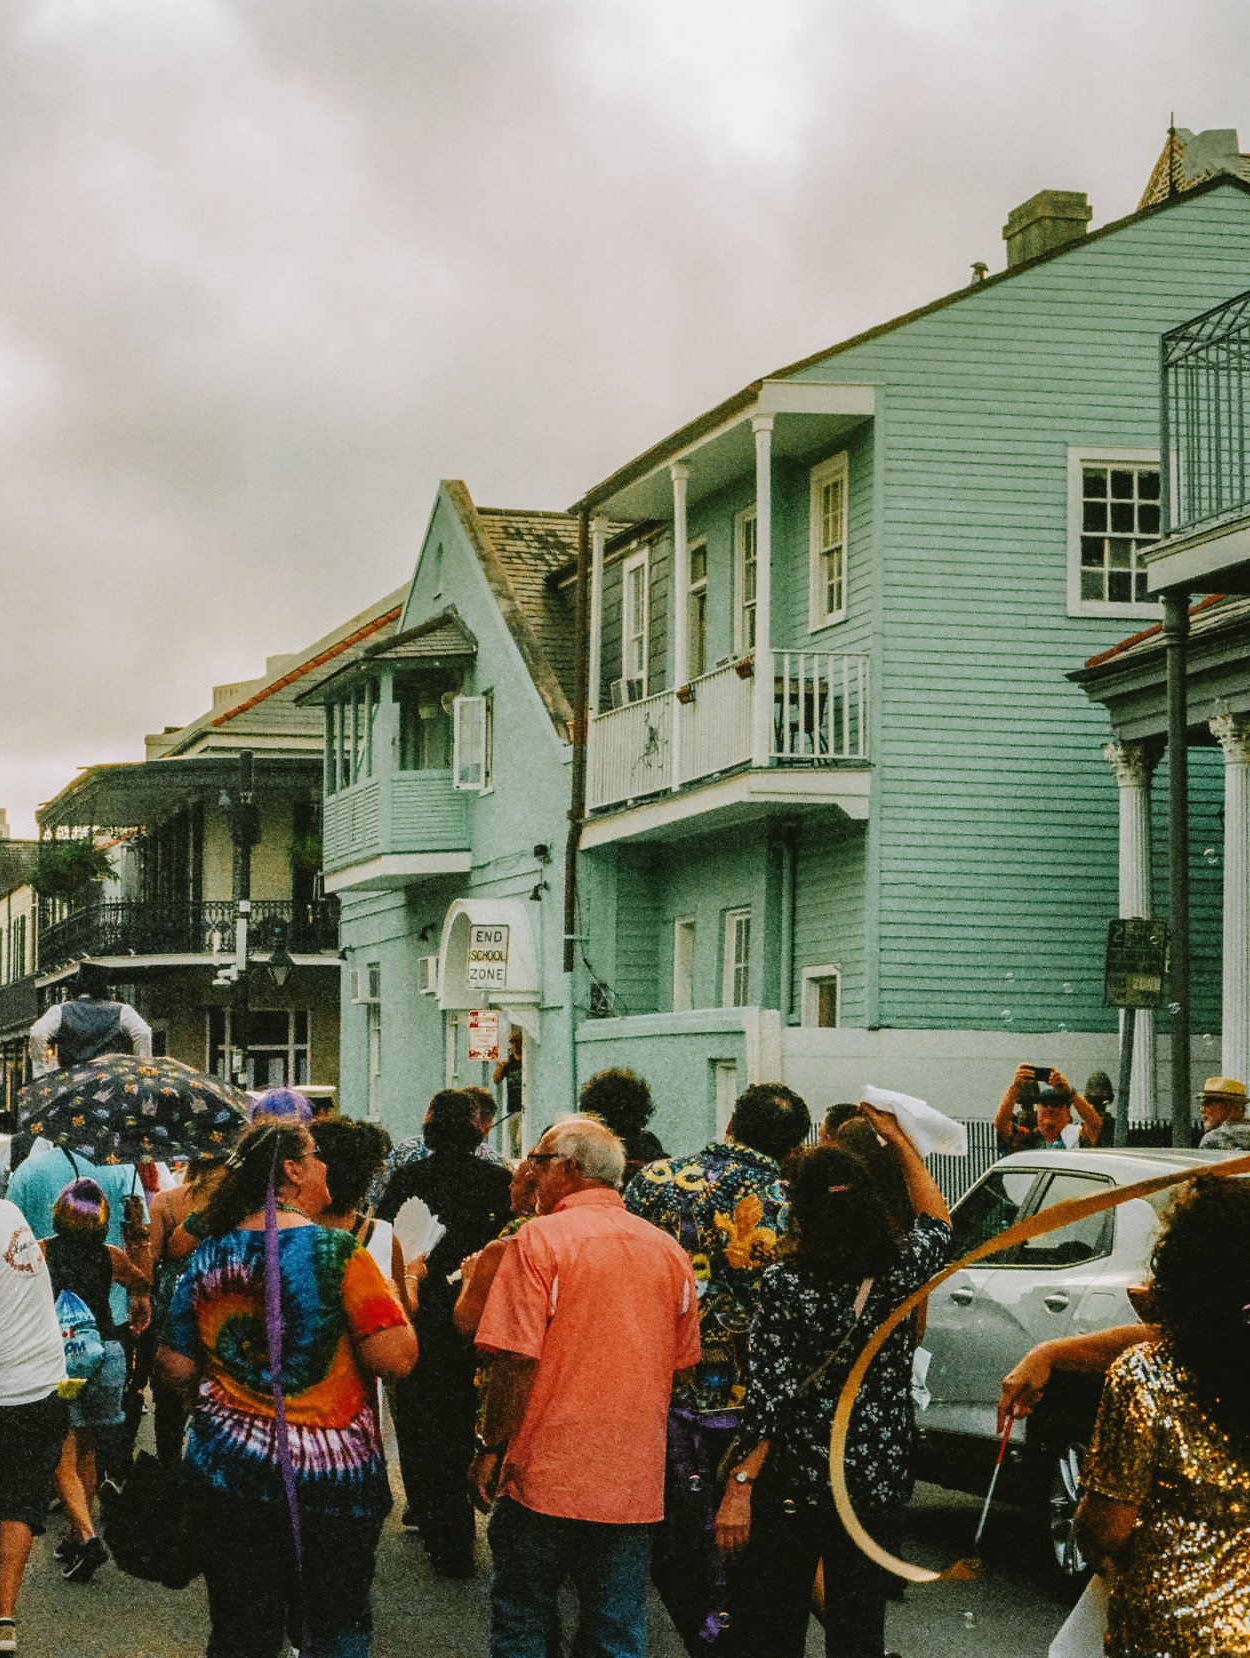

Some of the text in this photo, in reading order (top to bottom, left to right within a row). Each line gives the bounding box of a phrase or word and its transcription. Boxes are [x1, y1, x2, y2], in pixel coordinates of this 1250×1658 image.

[476, 931, 503, 943] END
[470, 949, 507, 962] SCHOOL
[469, 968, 504, 981] ZONE
